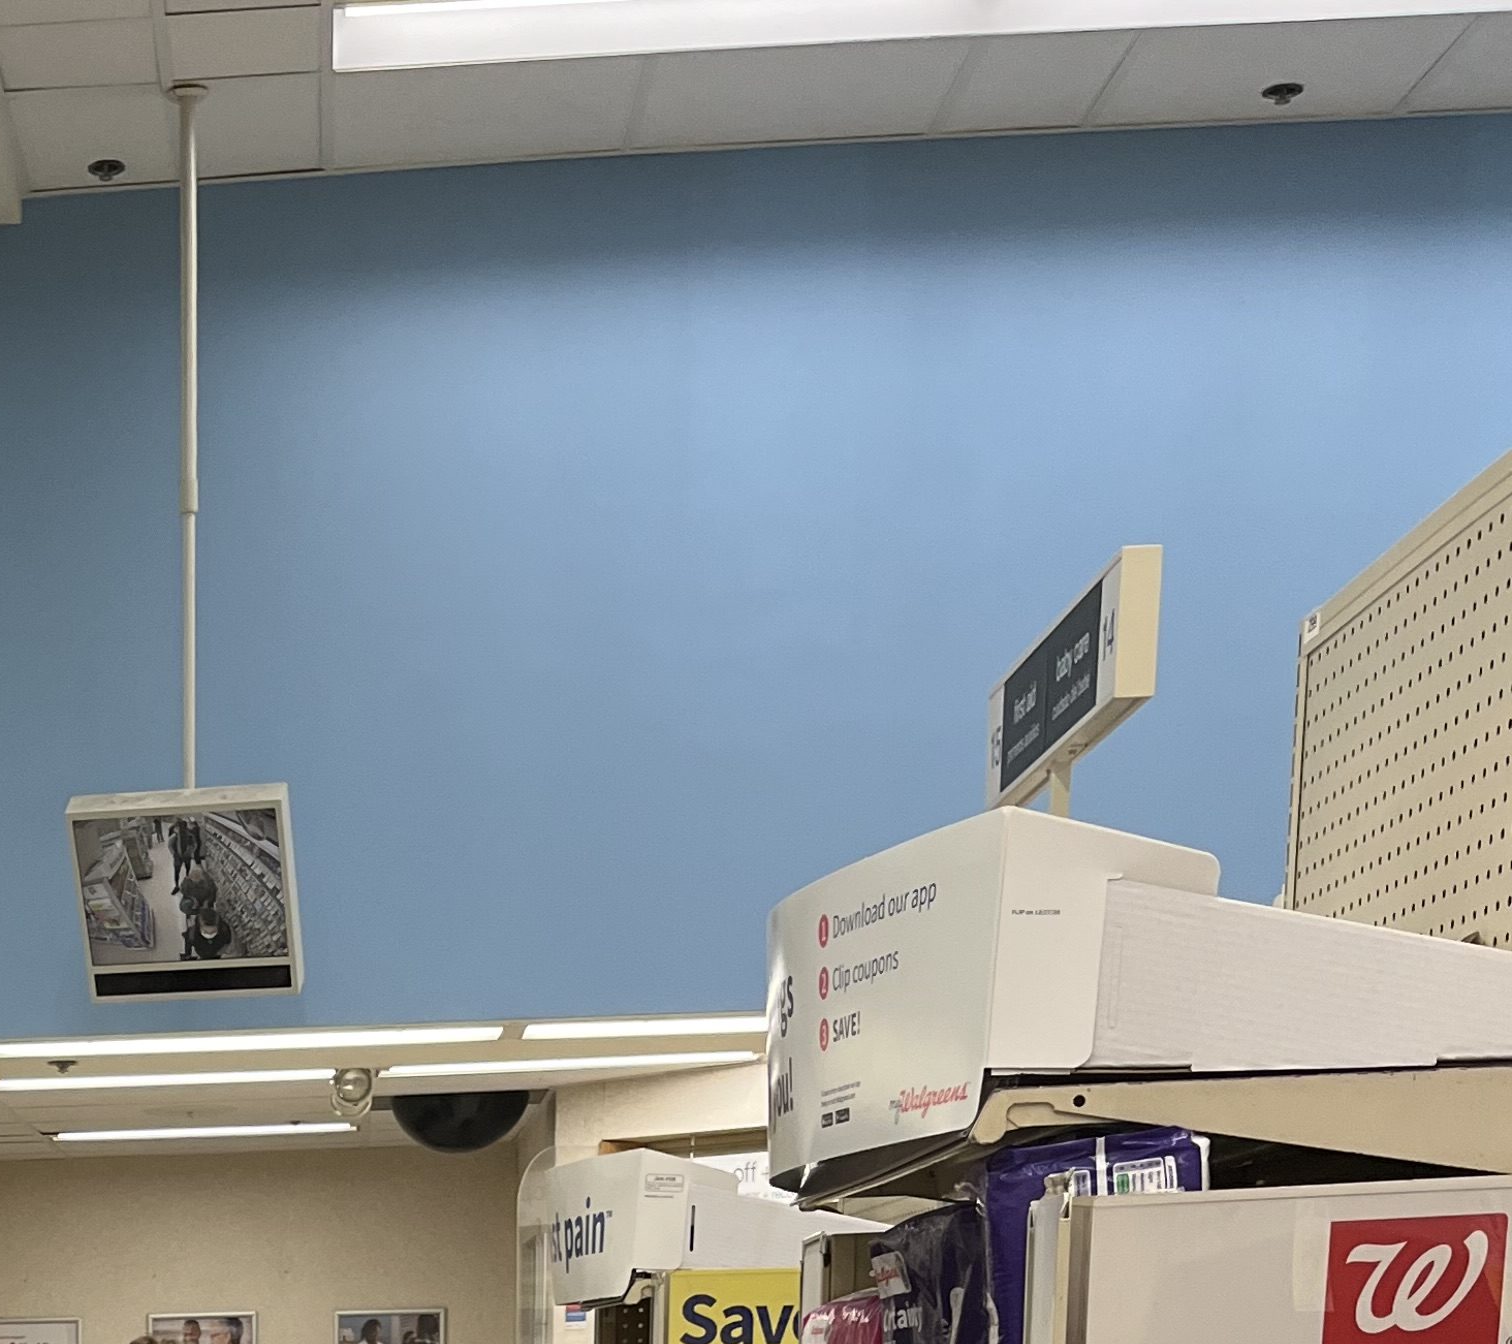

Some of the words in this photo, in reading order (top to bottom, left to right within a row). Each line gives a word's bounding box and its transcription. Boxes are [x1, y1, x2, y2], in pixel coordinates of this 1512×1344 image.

[1102, 607, 1115, 661] 14
[832, 893, 885, 939] Download
[887, 891, 910, 916] our
[911, 881, 938, 914] app
[832, 965, 851, 993] Clip
[851, 950, 900, 985] coupons
[832, 1010, 861, 1043] SAVE!
